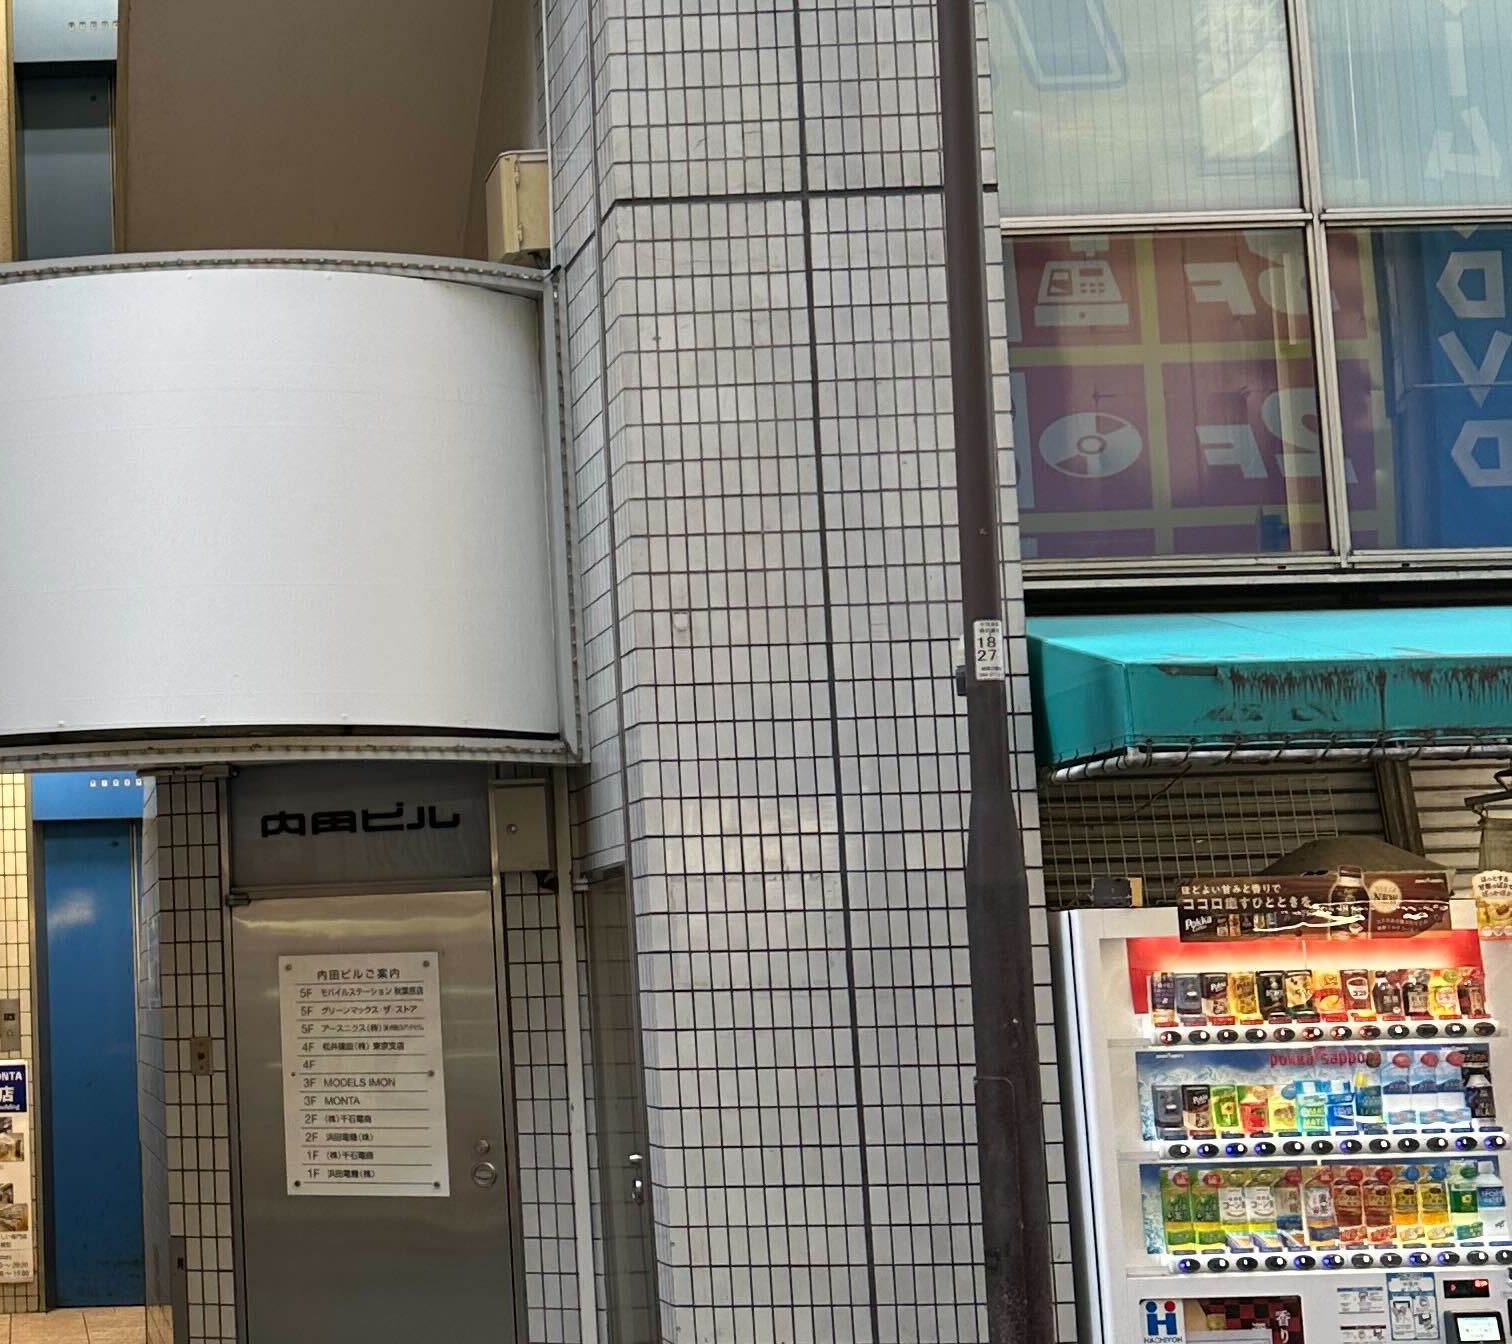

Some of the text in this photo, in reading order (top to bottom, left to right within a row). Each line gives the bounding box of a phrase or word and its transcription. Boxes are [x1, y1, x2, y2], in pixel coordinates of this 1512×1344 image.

[978, 636, 996, 648] 18
[977, 649, 997, 661] 27
[261, 803, 459, 837] 内田ビル
[1181, 884, 1281, 895] ほどよい甘みと香りで
[317, 968, 400, 981] 内田ビルご案内
[299, 988, 312, 998] 5F
[300, 1006, 313, 1016] 5F
[301, 1024, 314, 1034] 5F
[302, 1042, 315, 1052] 4F
[303, 1060, 315, 1069] 4F
[303, 1077, 396, 1088] 3F MODELS IMON
[304, 1095, 360, 1106] 3F MONTA
[304, 1114, 318, 1124] 2F
[305, 1132, 318, 1142] 2F
[307, 1150, 319, 1160] 1F
[307, 1168, 320, 1179] 1F
